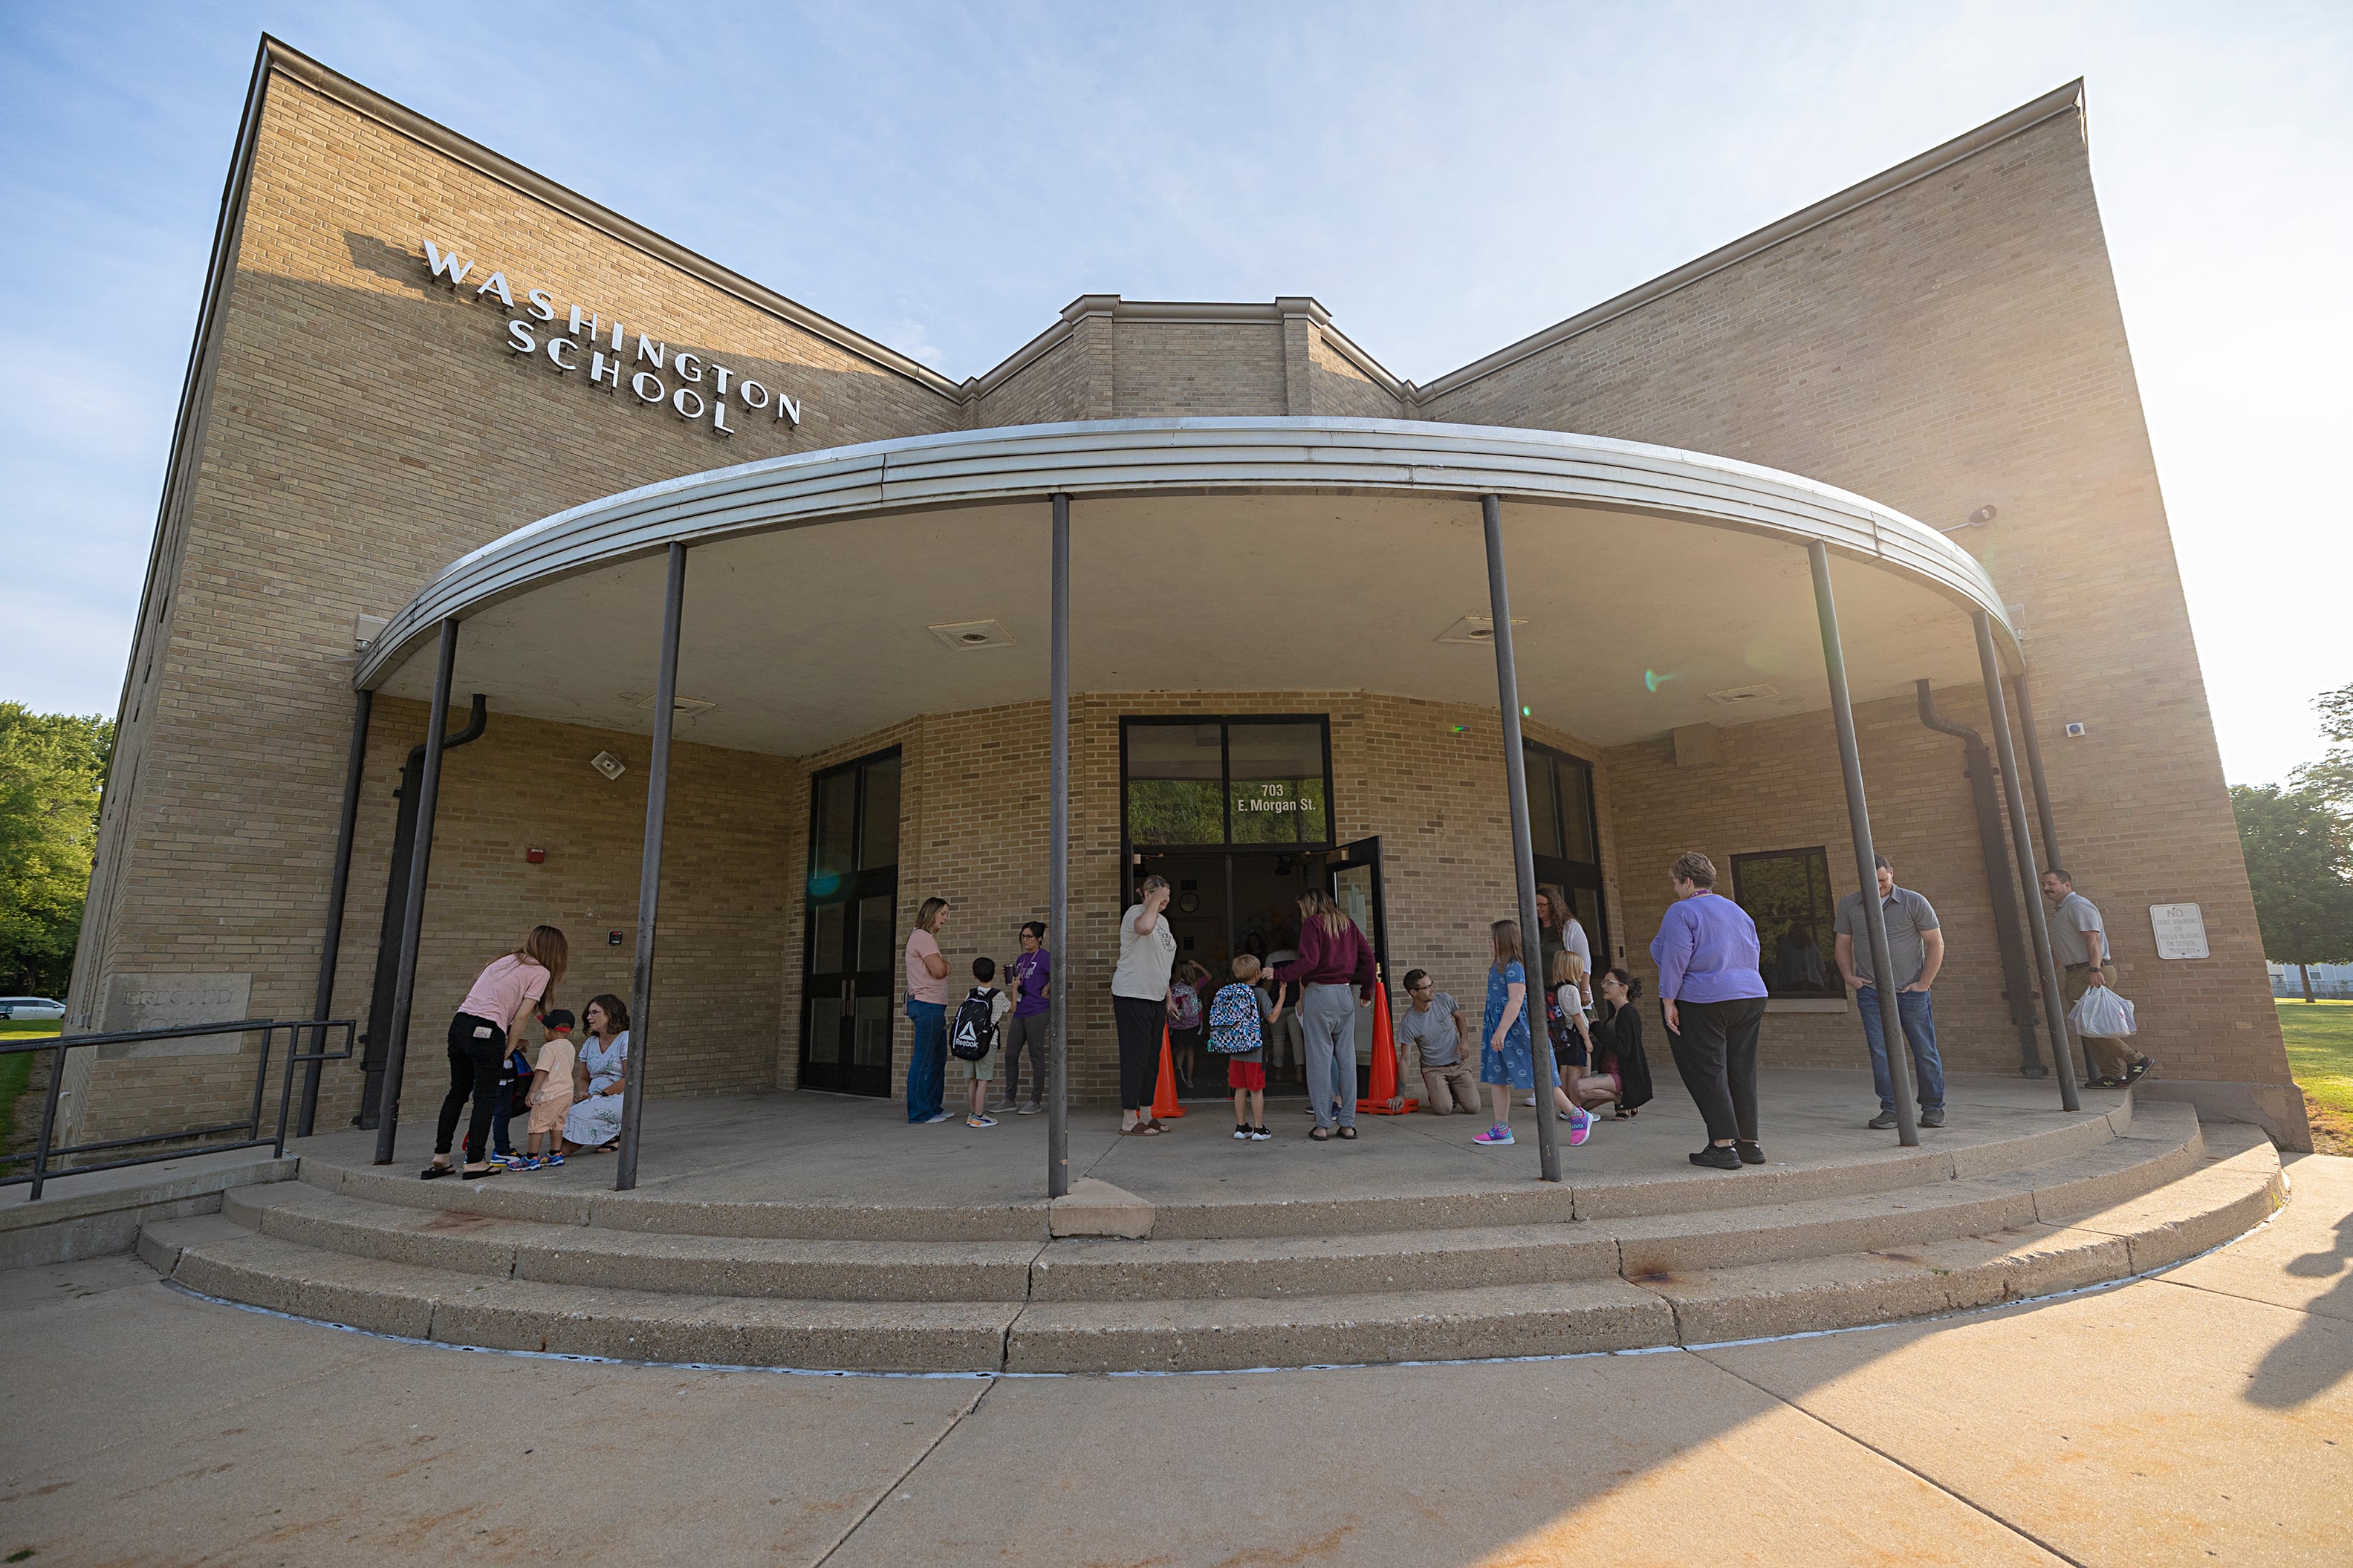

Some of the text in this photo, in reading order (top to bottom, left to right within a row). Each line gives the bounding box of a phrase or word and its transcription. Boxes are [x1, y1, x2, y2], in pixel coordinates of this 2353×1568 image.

[423, 239, 800, 425] WASHINGTON
[507, 320, 734, 434] SCHOOL
[1262, 784, 1283, 797] 703
[1238, 798, 1316, 813] E. Morgan St.
[2167, 909, 2184, 917] NO
[122, 989, 233, 1006] ERECTED
[955, 1038, 978, 1048] Reebok
